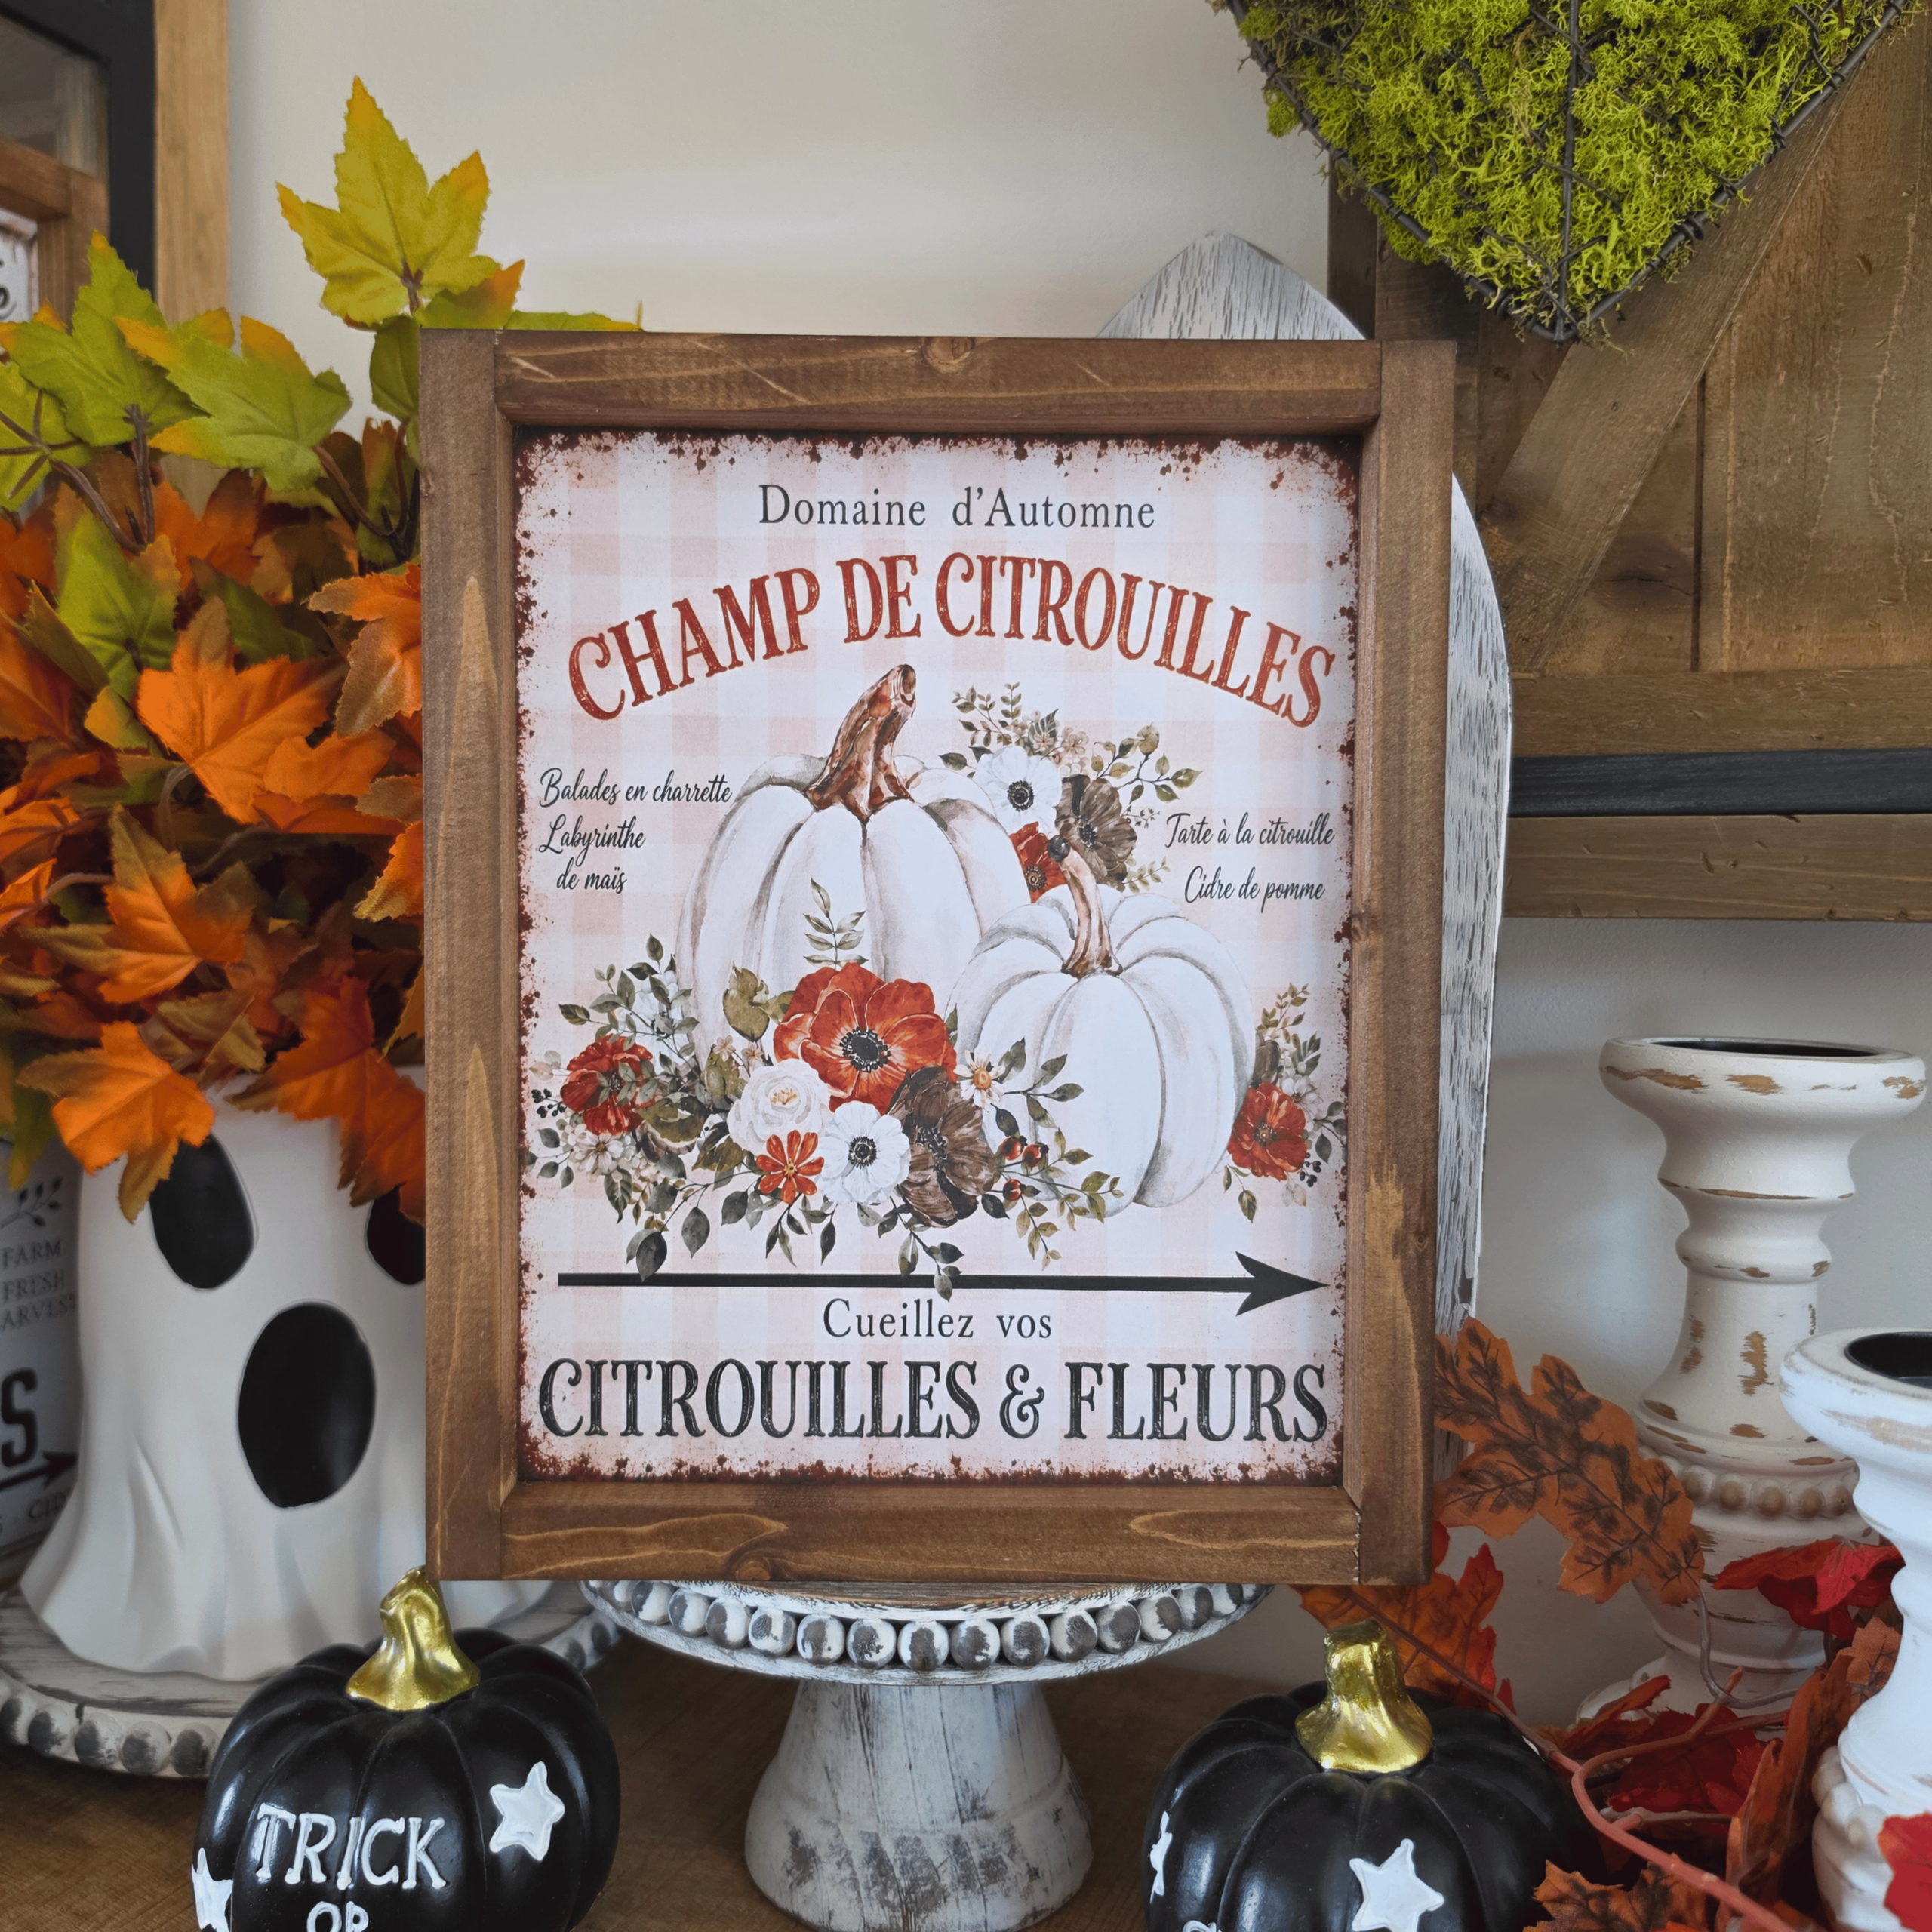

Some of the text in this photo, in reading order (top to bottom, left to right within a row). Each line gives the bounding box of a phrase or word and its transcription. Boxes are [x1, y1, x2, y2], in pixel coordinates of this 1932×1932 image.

[758, 484, 926, 525] Domaine
[568, 552, 1336, 728] CHAMP DE CITROUILLES
[539, 767, 734, 808] Balades en charrette
[538, 814, 646, 867] Labyrinthe
[1164, 812, 1335, 848] Tarte à la citrouille
[556, 857, 628, 894] de maïs
[1184, 866, 1325, 914] Cidre de pomme
[2, 1240, 61, 1269] FARM
[2, 1270, 66, 1303] FRESH
[823, 1297, 1052, 1339] Cueillez vos
[538, 1358, 1327, 1443] CITROUILLES & FLEURS
[256, 1802, 448, 1890] TRICK
